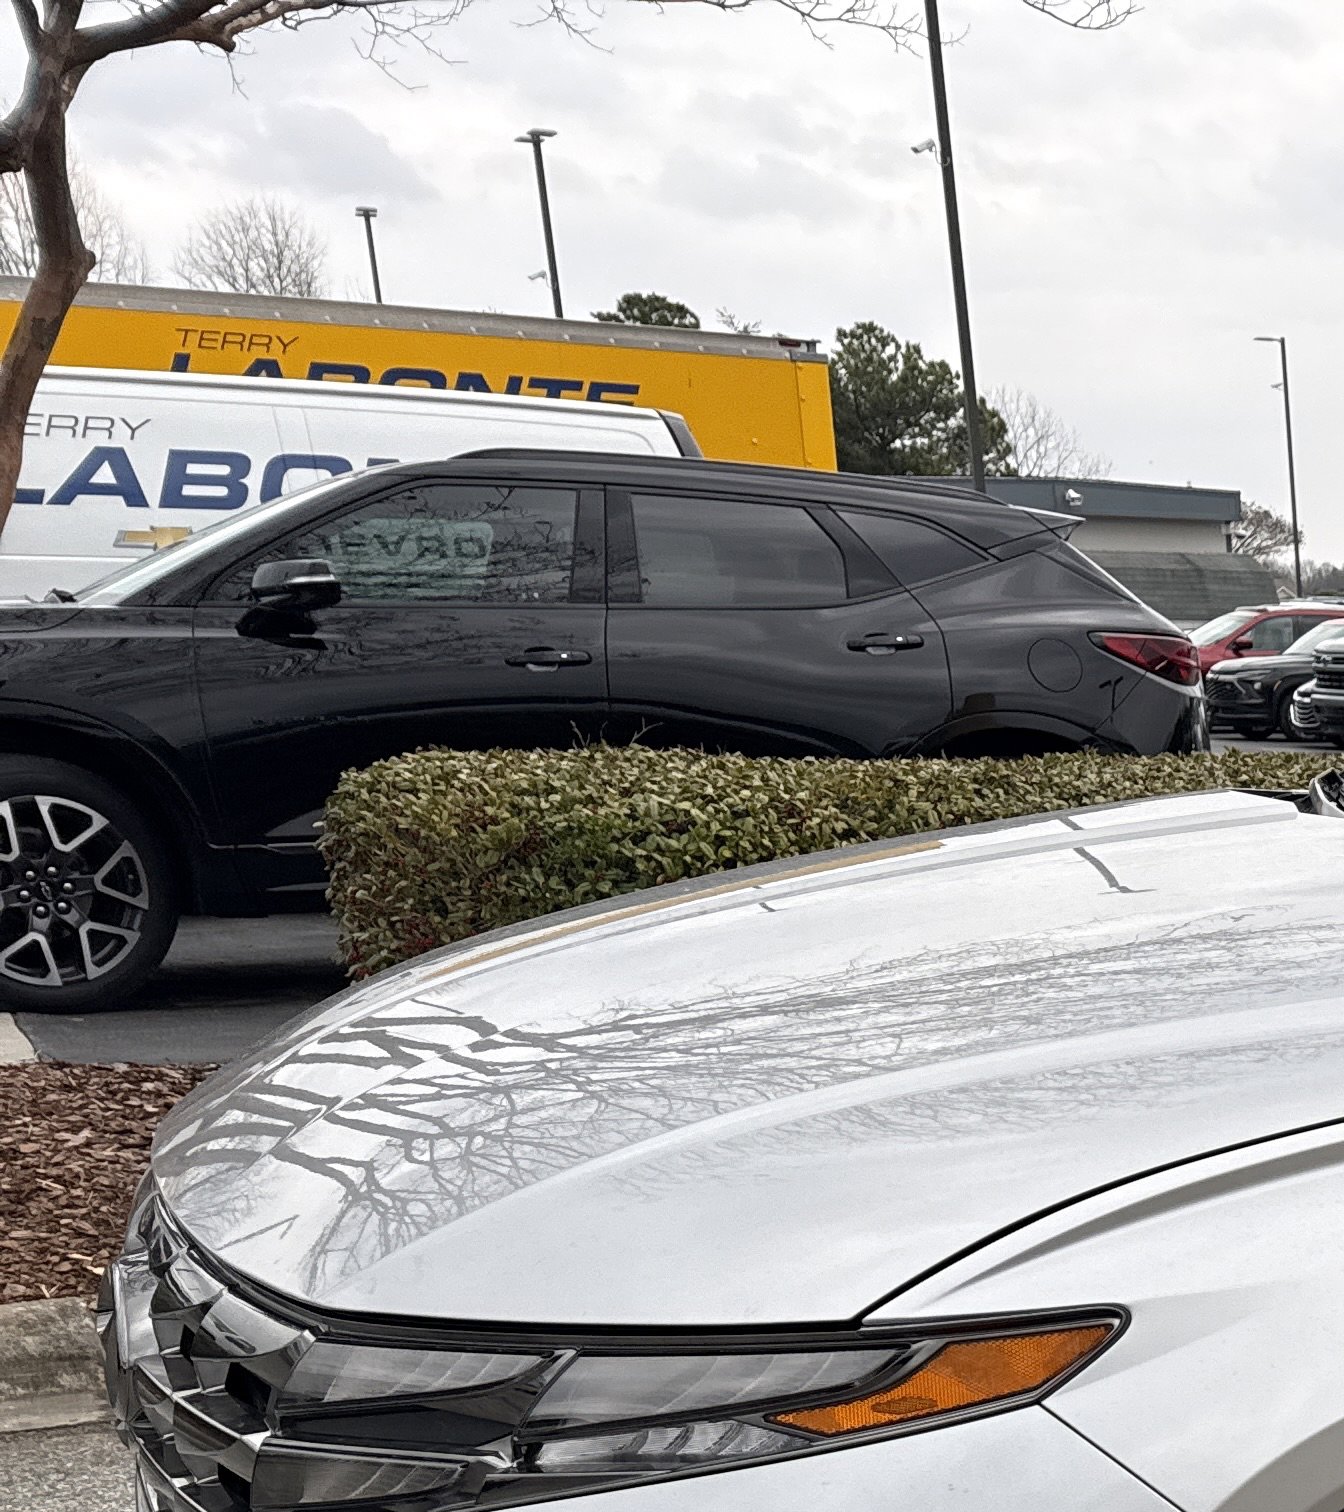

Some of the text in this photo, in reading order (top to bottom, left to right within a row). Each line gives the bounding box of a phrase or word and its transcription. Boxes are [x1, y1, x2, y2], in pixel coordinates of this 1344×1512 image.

[175, 327, 299, 354] TERRY
[23, 413, 151, 440] ERRY
[14, 445, 400, 510] ABO
